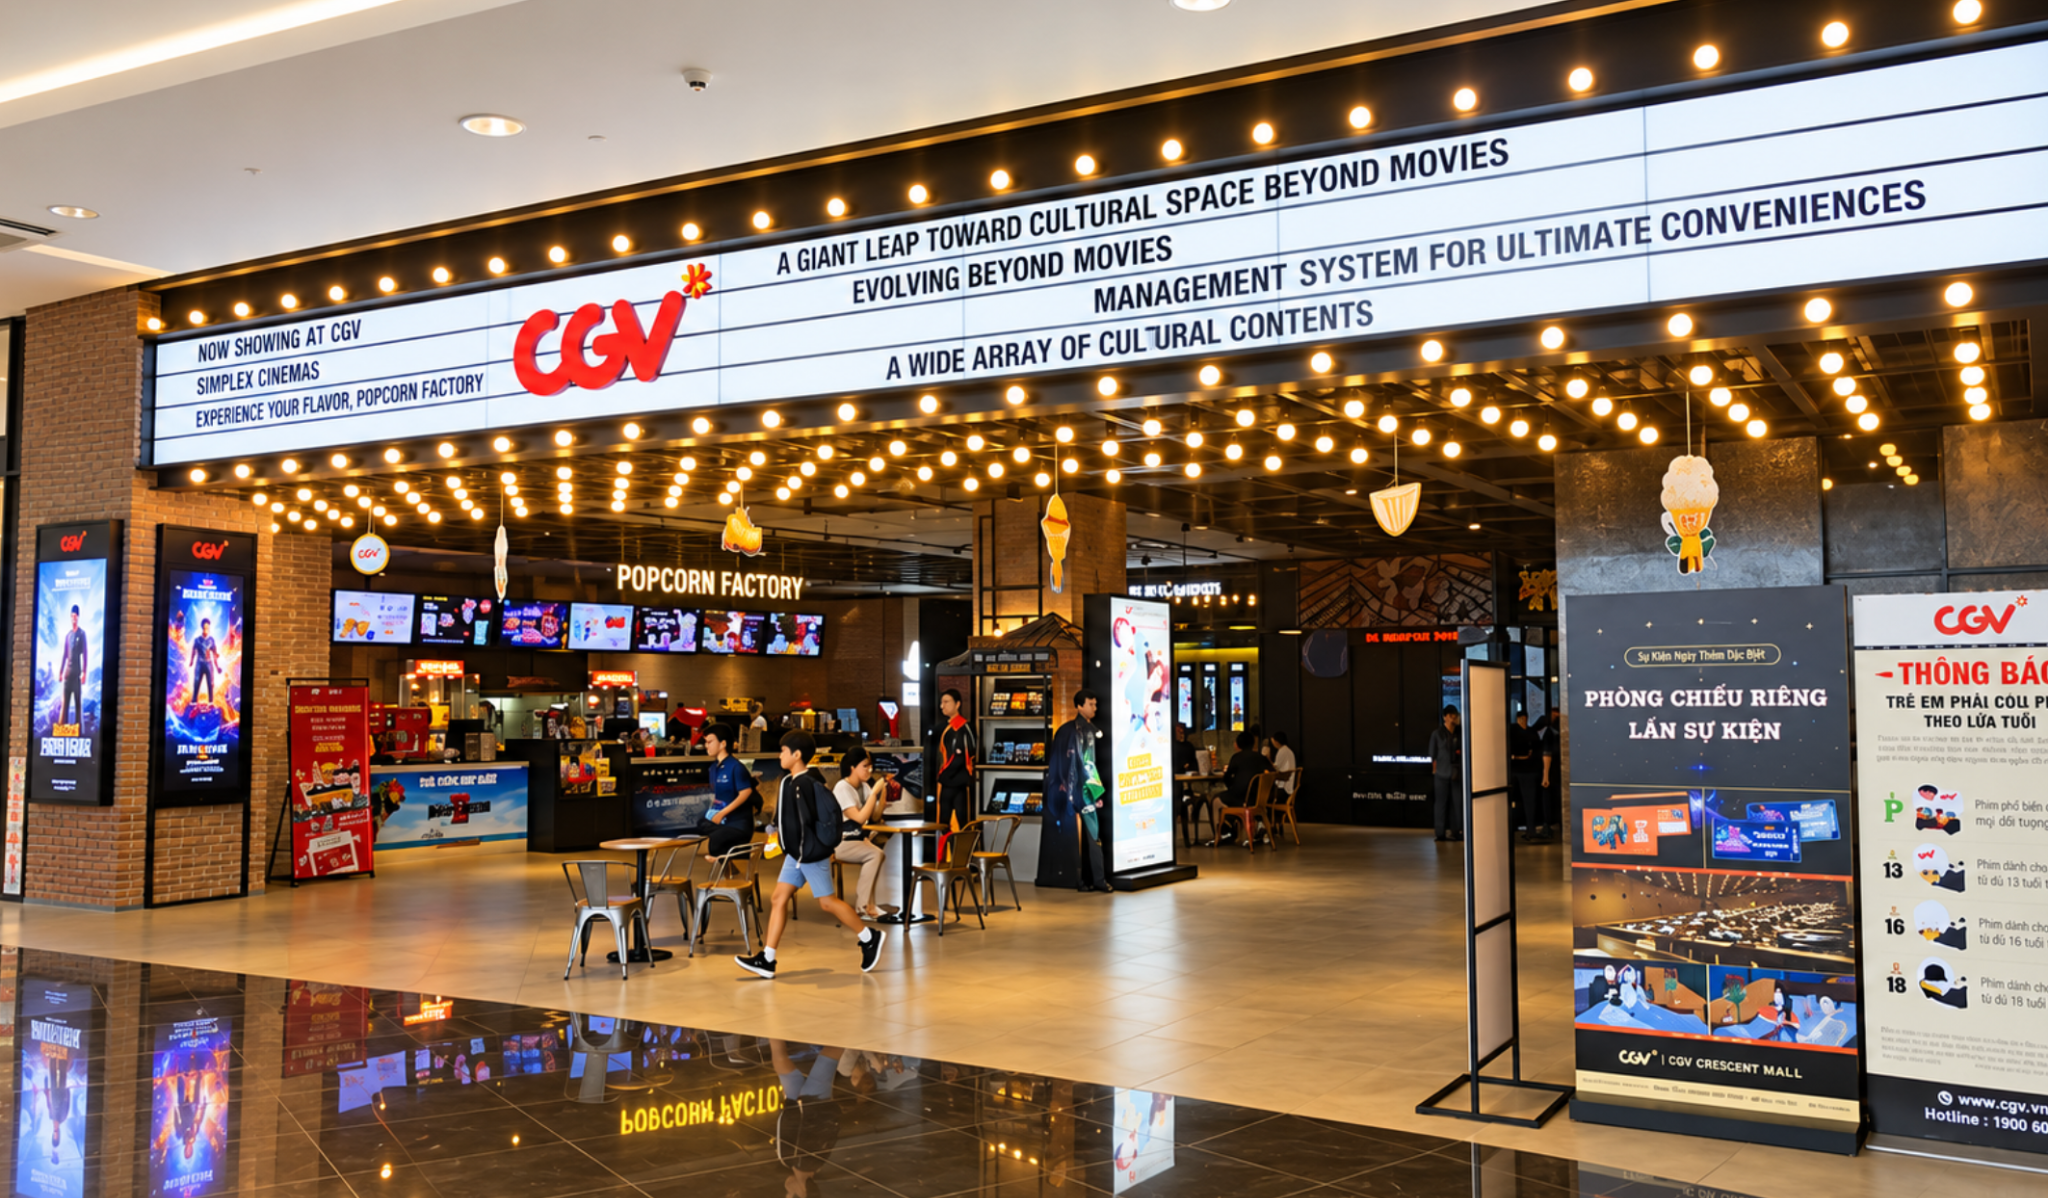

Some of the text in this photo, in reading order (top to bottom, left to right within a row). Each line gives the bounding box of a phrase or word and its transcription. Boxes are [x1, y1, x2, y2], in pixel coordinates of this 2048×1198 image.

[777, 137, 1509, 275] A GIANT LEAP TOWARD CULTURAL SPACE BEYOND MOVIES
[1094, 179, 1927, 314] MANAGEMENT SYSTEM FOR ULTIMATE CONVENIENCES
[853, 234, 1173, 304] EVOLVING BEYOND MOVIES
[198, 318, 362, 363] NOW SHOWING AT CGV
[513, 289, 687, 396] CGV
[886, 355, 902, 381] A
[908, 347, 966, 378] WIDE
[972, 337, 1053, 371] ARRAY
[1060, 333, 1092, 361] OF
[1230, 299, 1374, 342] CONTENTS
[196, 360, 320, 396] SIMPLEX CINEMAS
[196, 373, 484, 428] EXPERIENCE YOUR FLAVOR, POPCORN FACTORY
[60, 535, 84, 552] CGV
[191, 540, 225, 560] CGV
[617, 564, 804, 600] POPCORN FACTORY
[1933, 603, 2017, 636] CGV
[1897, 656, 1990, 685] THÔNG
[1585, 683, 1828, 707] PHÒNG CHIẾU RIÊNG
[1921, 695, 1945, 709] EM
[1721, 718, 1781, 744] KIỆN
[1924, 714, 1962, 728] THEO
[1975, 799, 1999, 810] Phim
[1883, 862, 1904, 879] 13
[1977, 859, 2001, 870] Phim
[2007, 877, 2020, 887] 13
[1885, 918, 1905, 935] 16
[1979, 917, 2003, 929] Phim
[2009, 936, 2022, 947] 16
[1886, 976, 1907, 994] 18
[1981, 976, 2005, 989] Phim
[2011, 996, 2024, 1007] 18
[1618, 1050, 1803, 1079] CGV CGV CRESCENT MALL
[1958, 1095, 2048, 1115] www.cgv.vn
[1924, 1107, 1979, 1126] Hotline
[1993, 1116, 2028, 1132] 1900
